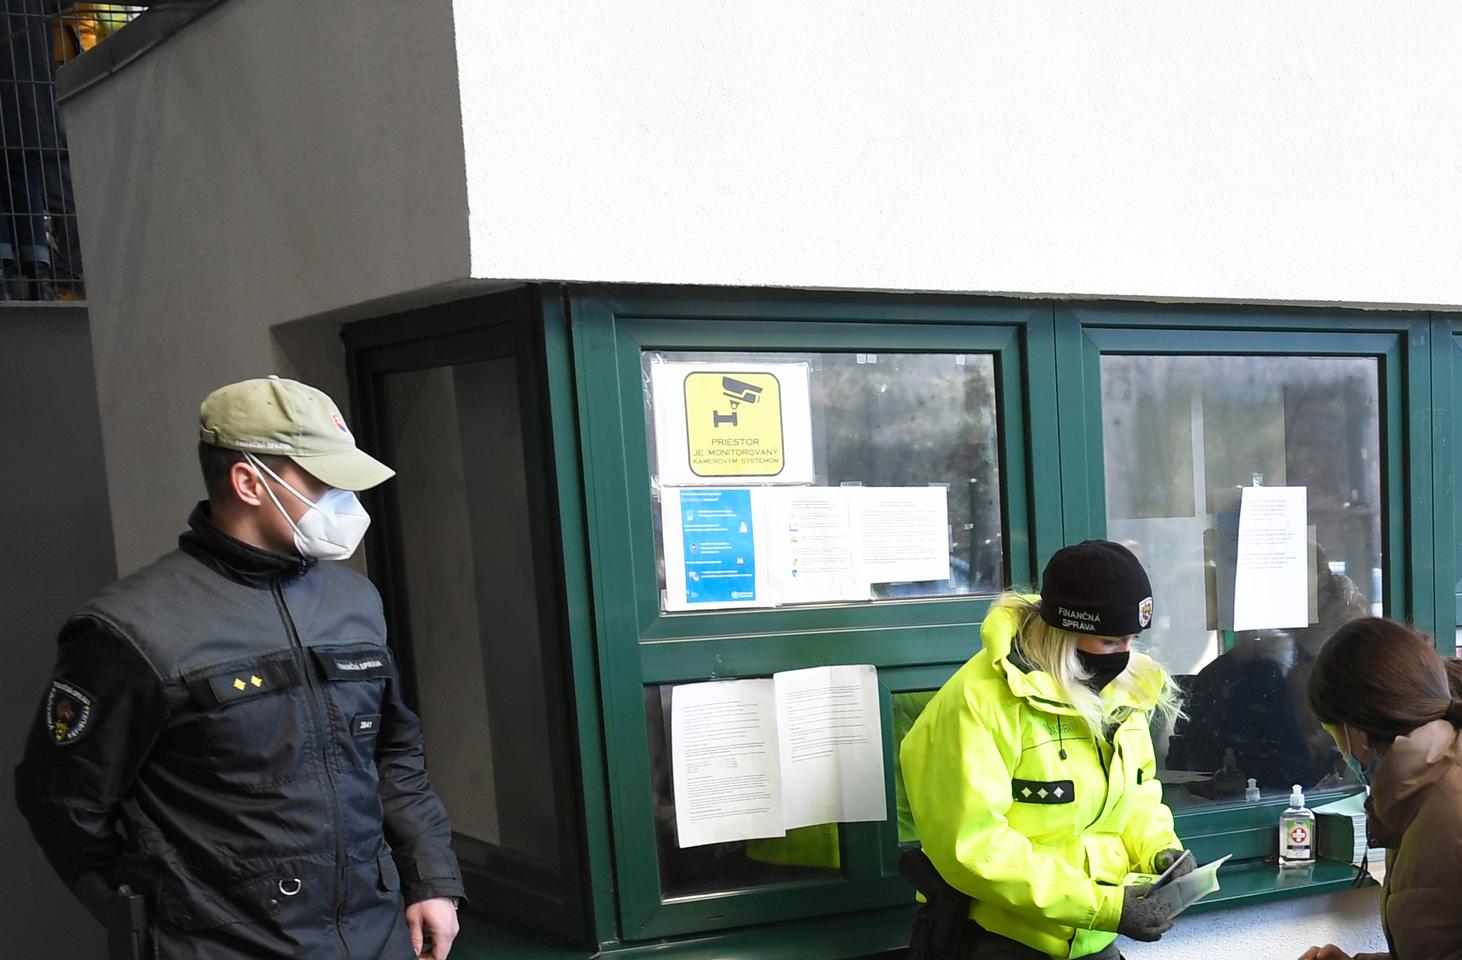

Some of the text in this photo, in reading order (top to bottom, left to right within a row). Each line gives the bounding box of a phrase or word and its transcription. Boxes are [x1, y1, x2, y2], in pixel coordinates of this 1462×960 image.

[711, 438, 760, 446] PRIESTOR
[1058, 606, 1101, 623] FINANČNÁ
[1062, 618, 1096, 632] SPRÁVA
